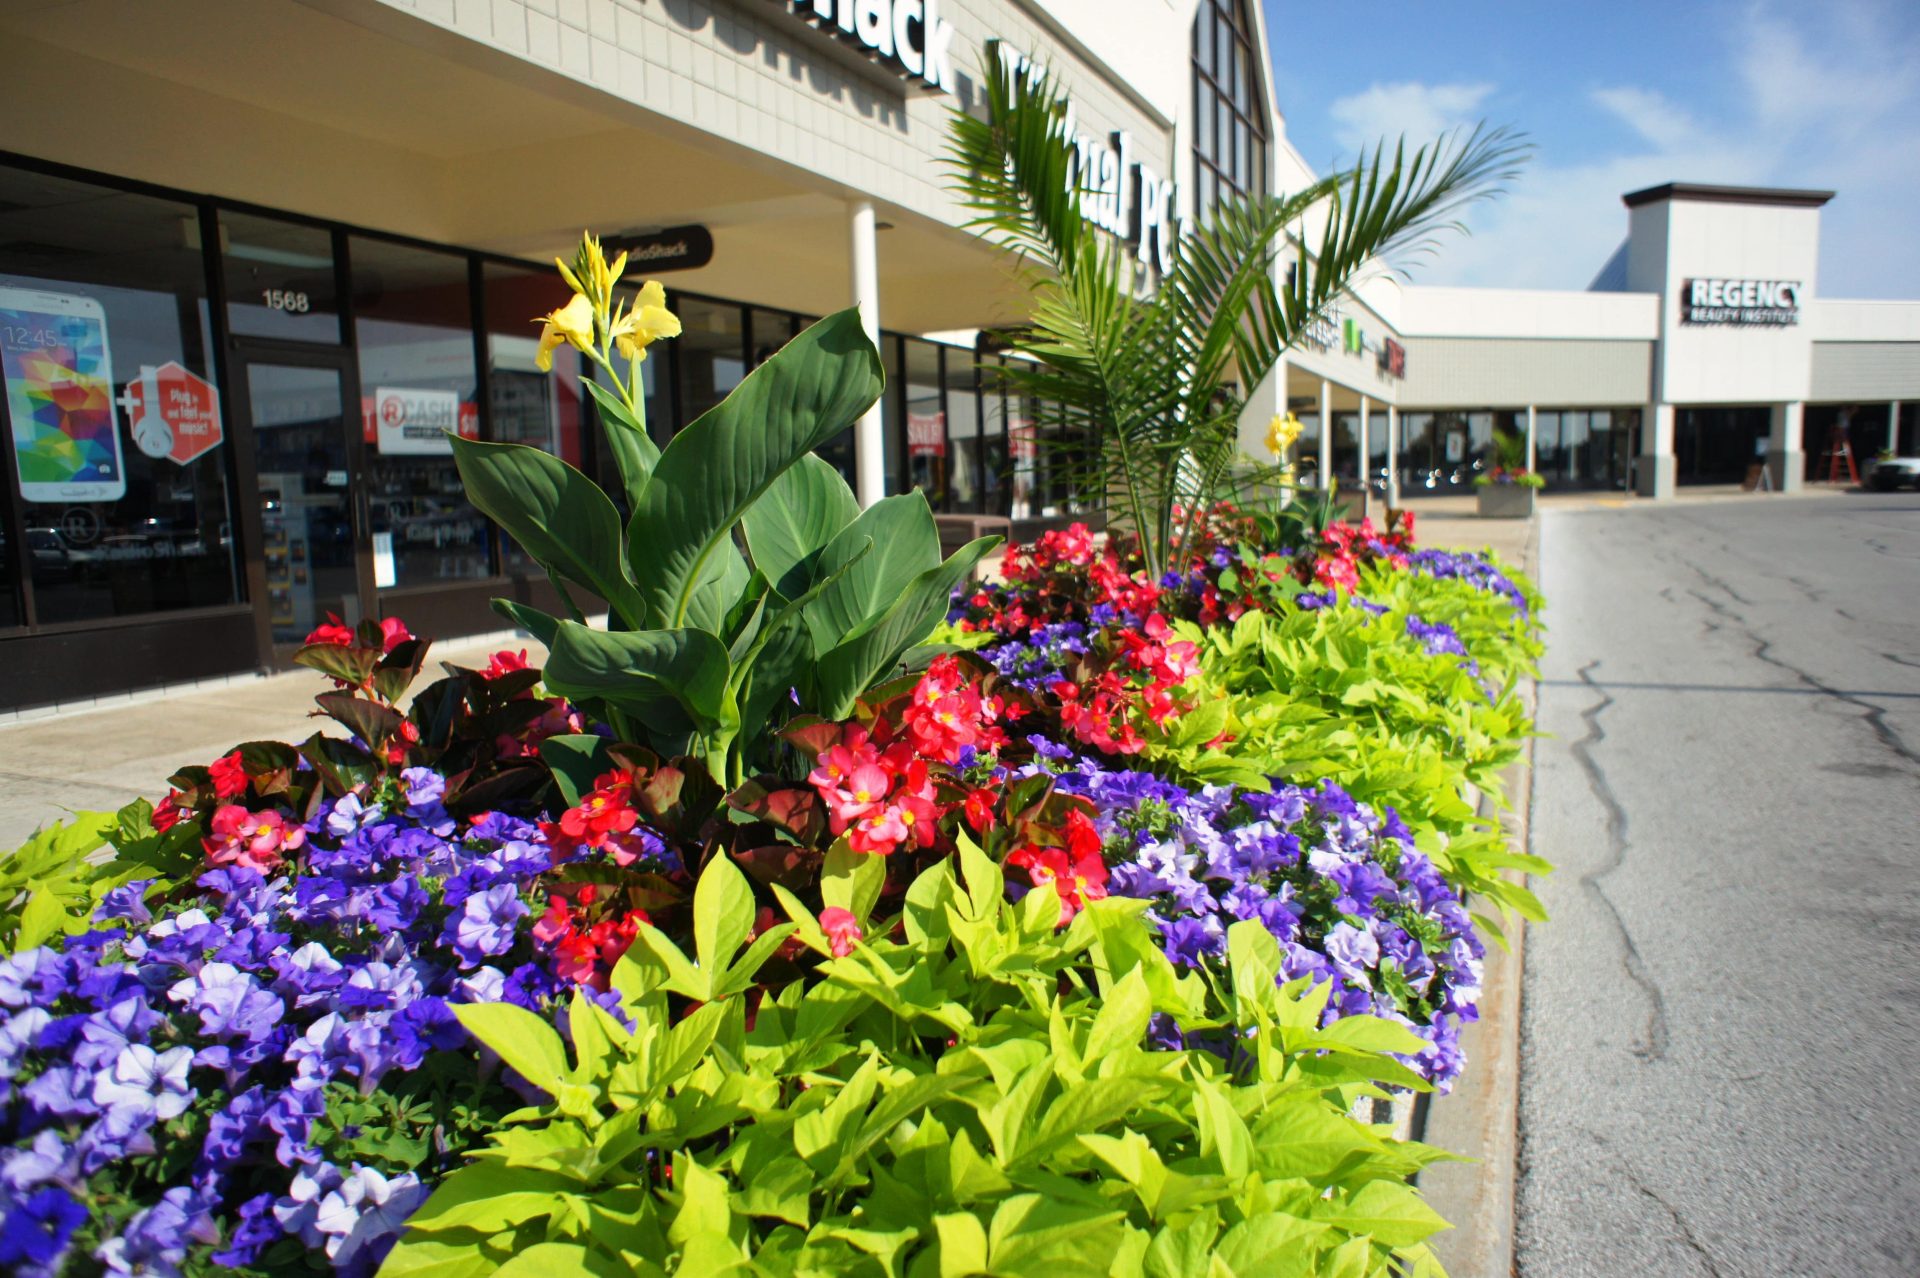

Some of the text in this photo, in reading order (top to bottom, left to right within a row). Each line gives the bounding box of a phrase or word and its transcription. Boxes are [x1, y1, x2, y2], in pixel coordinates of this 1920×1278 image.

[262, 288, 309, 313] 1568
[1691, 279, 1799, 307] REGENCY
[4, 326, 57, 347] 12:45
[405, 400, 452, 422] CASH
